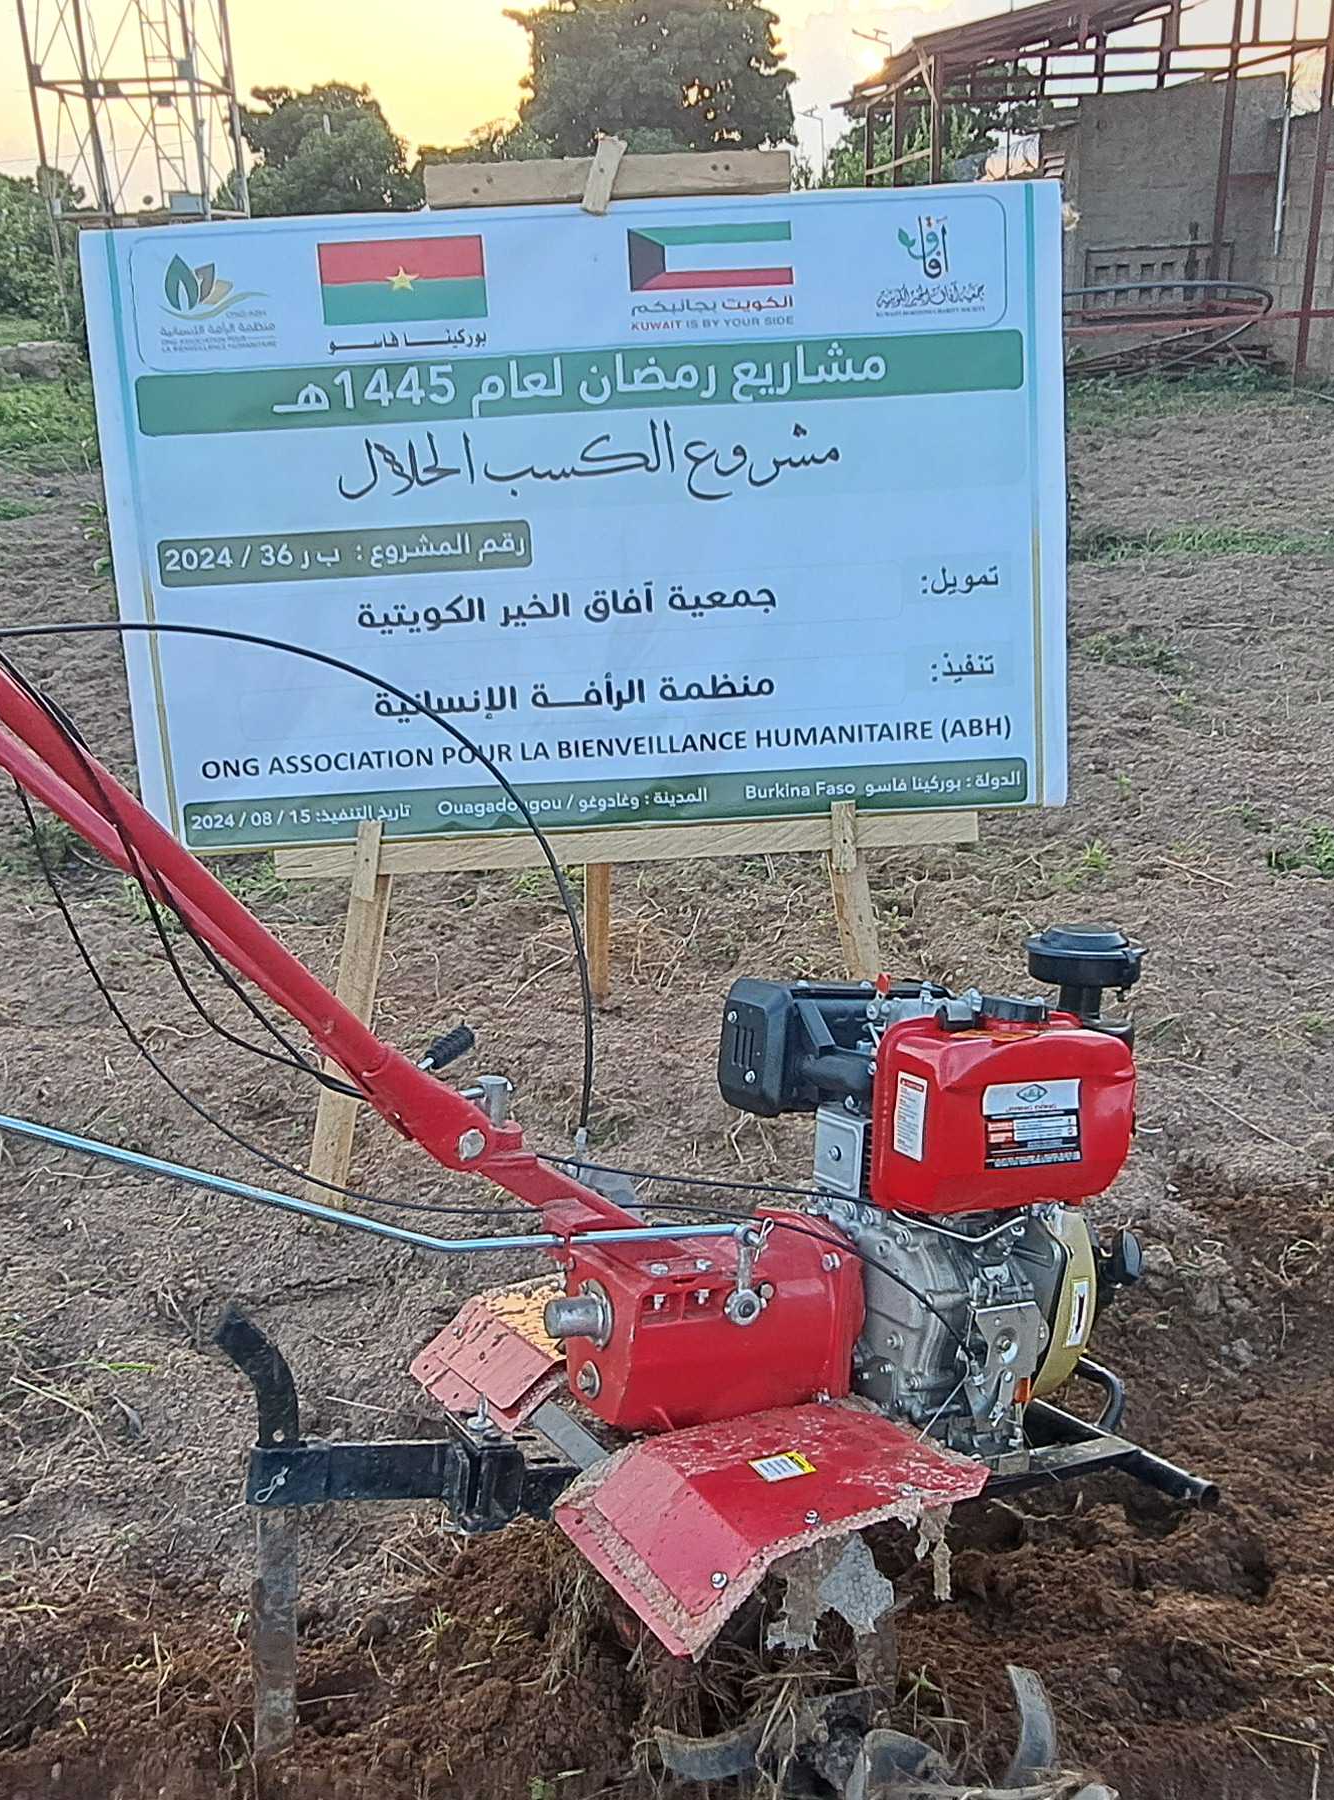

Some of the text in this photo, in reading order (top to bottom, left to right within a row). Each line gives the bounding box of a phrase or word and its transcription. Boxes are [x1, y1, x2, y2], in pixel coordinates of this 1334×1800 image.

[631, 295, 794, 317] الكويت بجانبكم
[631, 315, 794, 331] KUWAIT IS BY YOUR SIDE
[578, 353, 716, 405] رمضان
[732, 341, 887, 402] مشاريع
[470, 358, 565, 418] لعام
[338, 418, 840, 501] مشروع الكسب الحلال
[260, 543, 293, 566] 36
[370, 532, 470, 568] المشروع
[478, 532, 525, 562] رقم
[164, 547, 234, 572] 2024
[921, 565, 1000, 596] تمويل:
[357, 581, 777, 635] جمعية آفاق الخير الكويتية
[931, 652, 994, 684] تنفيذ:
[659, 673, 775, 703] منظمة
[374, 684, 517, 724] الإنسانية
[201, 715, 1011, 780] ONG ASSOCIATION POUR LA BIENVEILLANCE HUMANITAIRE (ABH)
[745, 782, 811, 800] Burkina
[815, 780, 856, 798] Faso
[865, 777, 907, 797] فاسو
[912, 774, 961, 794] بوركينا
[975, 770, 1021, 790] الدولة
[437, 796, 562, 818] Ouagadogou
[653, 786, 708, 807] المدينة
[191, 813, 236, 831] 2024
[250, 811, 273, 827] 08
[289, 808, 311, 825] 15
